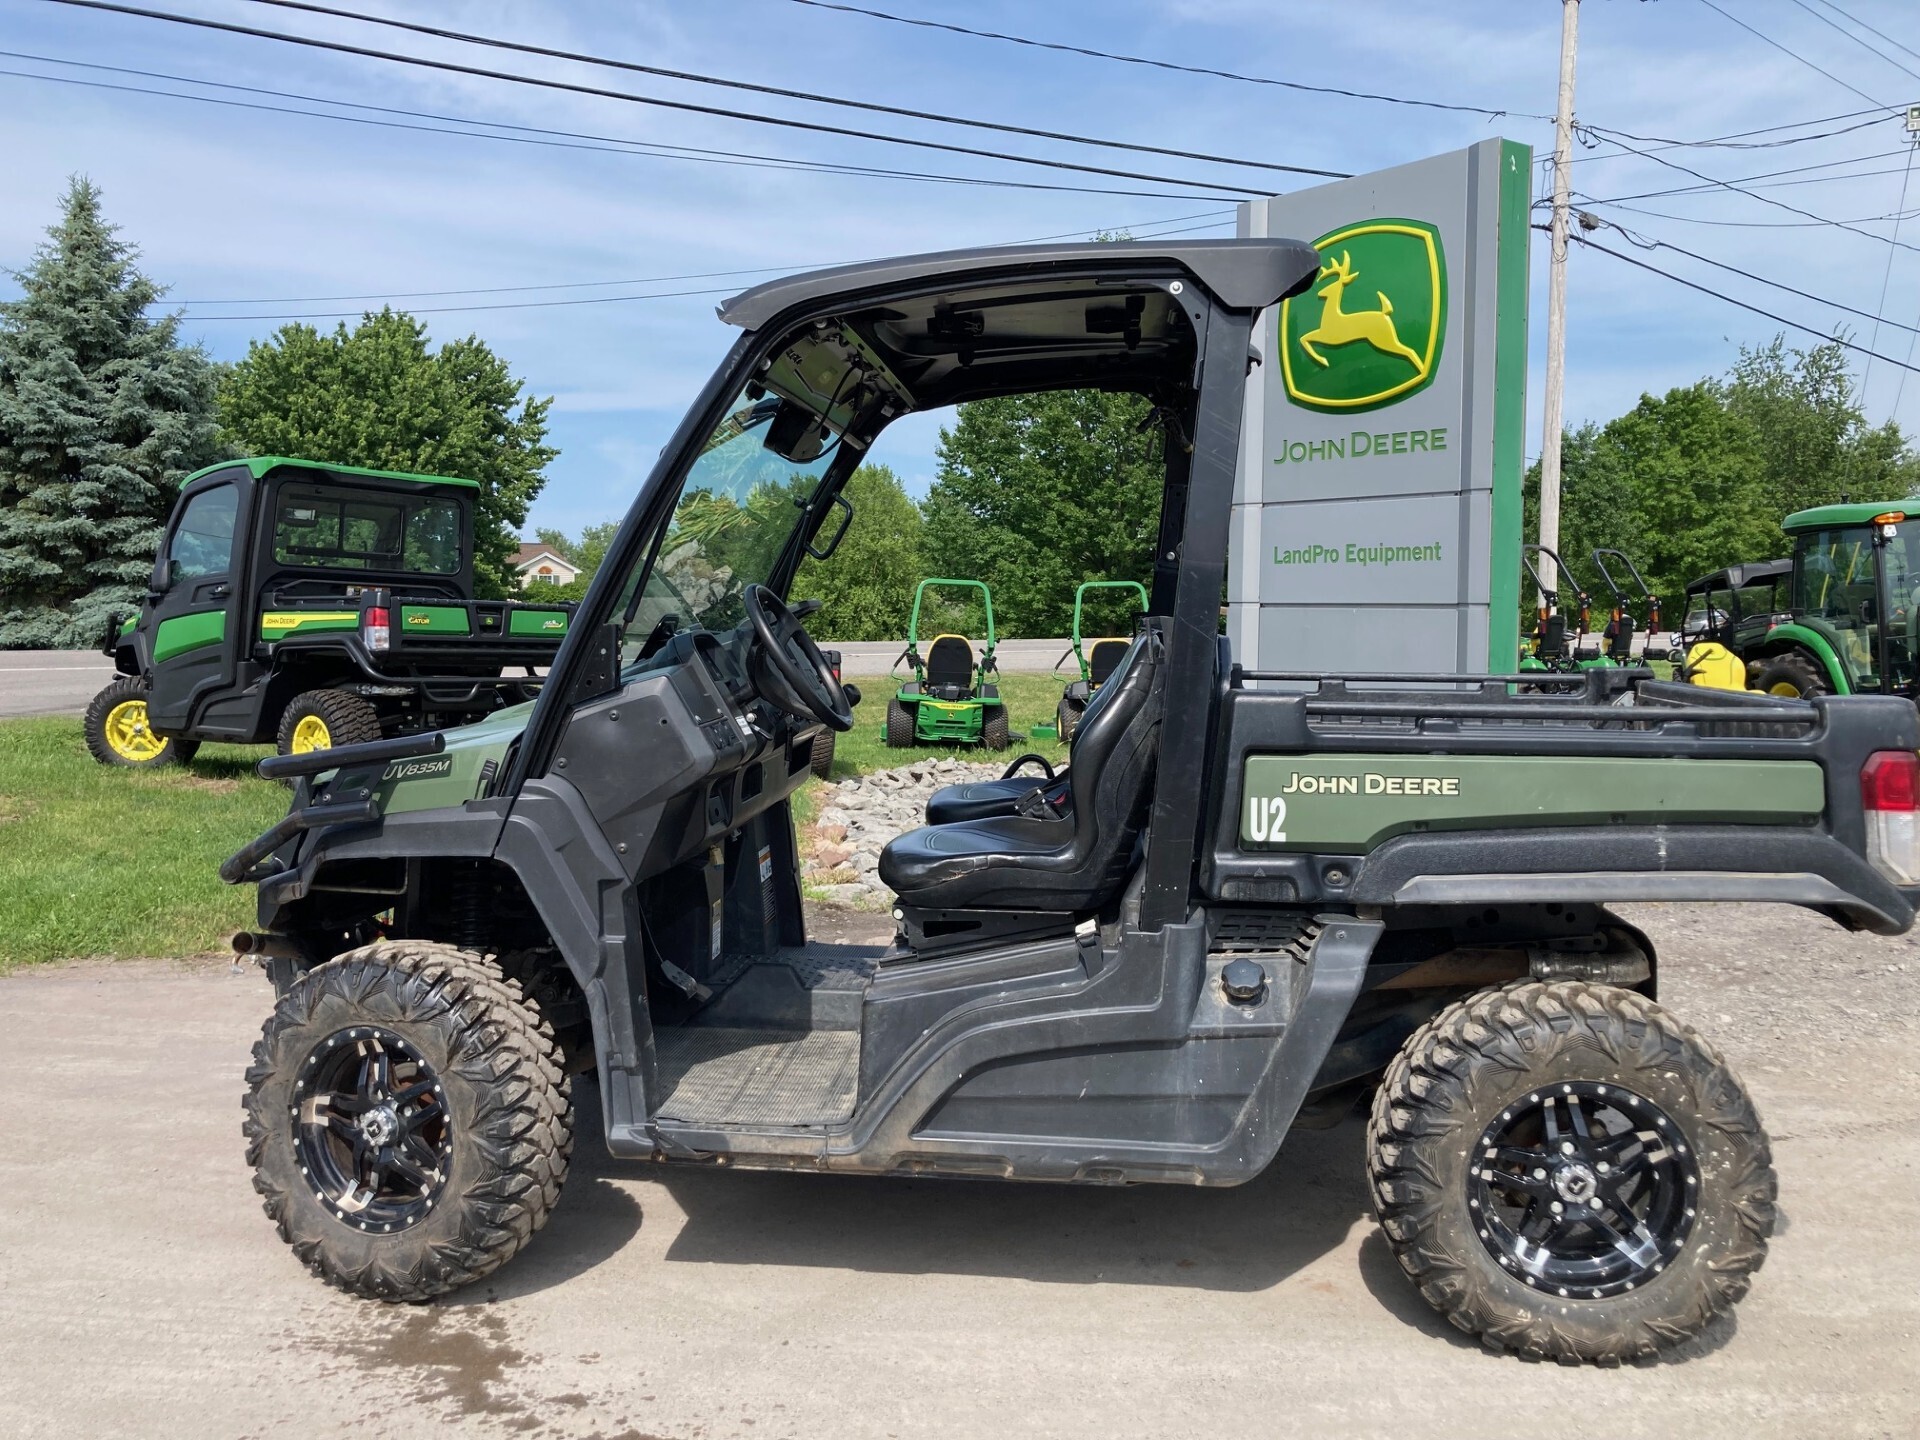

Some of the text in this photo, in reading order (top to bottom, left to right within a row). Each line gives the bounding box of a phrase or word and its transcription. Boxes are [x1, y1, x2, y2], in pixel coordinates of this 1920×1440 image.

[1273, 427, 1448, 465] JOHN DEERE
[1273, 541, 1442, 566] LandPro Equipment
[265, 617, 296, 625] JOHN DEERE
[381, 760, 451, 780] UV835M
[1282, 772, 1460, 796] JOHN DEERE
[1250, 797, 1287, 842] U2
